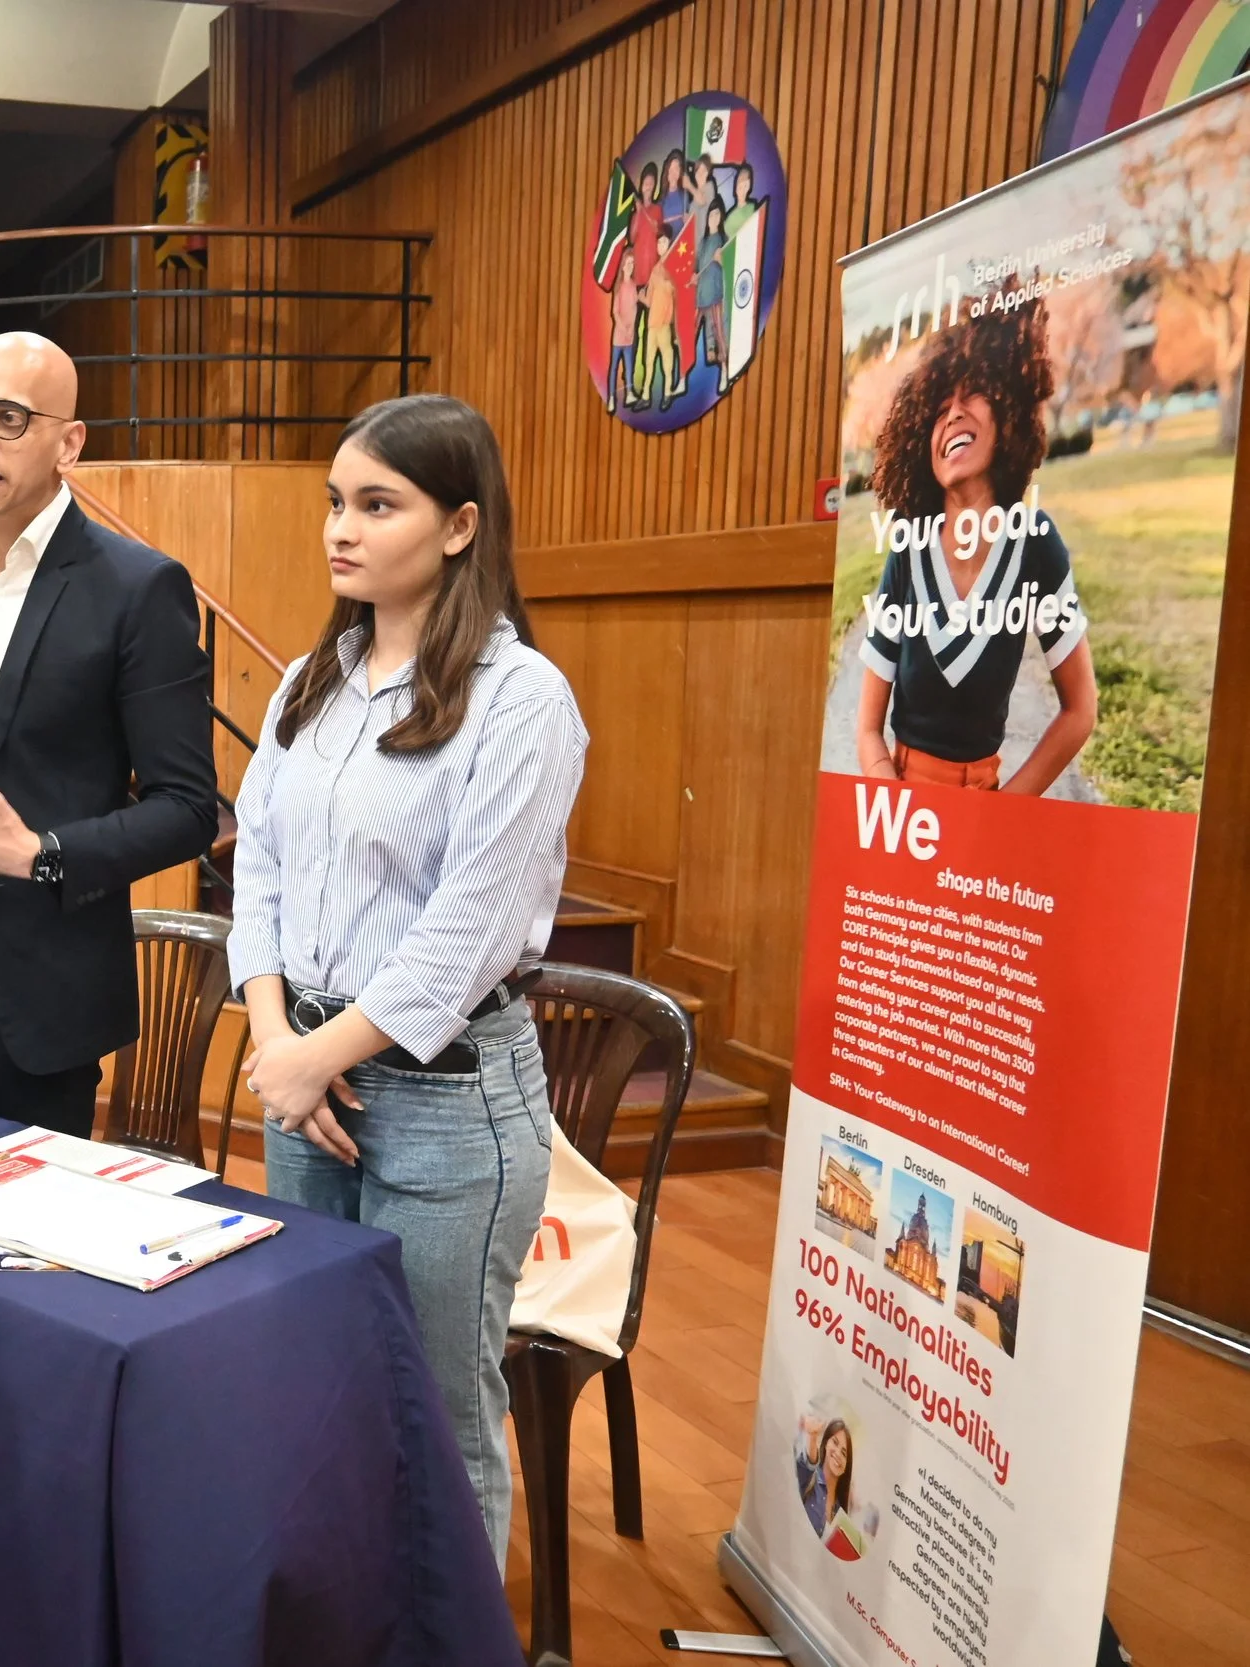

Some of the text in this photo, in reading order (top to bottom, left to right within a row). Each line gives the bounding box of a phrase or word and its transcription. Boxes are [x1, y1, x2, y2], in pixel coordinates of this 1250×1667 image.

[970, 248, 1133, 319] of Applied Sciences
[973, 222, 1107, 287] Berlin University
[870, 484, 1050, 561] Your goal.
[862, 581, 1088, 638] Your studies.
[855, 783, 940, 861] We
[846, 885, 1042, 945] Six schools in three cities, with students from
[936, 867, 1054, 914] shape the future
[842, 919, 1037, 987] CORE Principle gives you a flexible, dynamic
[844, 901, 1027, 960] both Germany and all over the world. Our
[839, 955, 1032, 1033] Our Career Services support you all the way
[841, 940, 1045, 1012] and fun study framework based on your needs.
[835, 1011, 1025, 1093] corporate partners, we are proud to say that
[836, 994, 1034, 1075] entering the job market. With more than 3500
[838, 973, 1035, 1057] from defining your career path to successfully
[832, 1043, 884, 1076] in Germany.
[833, 1027, 1026, 1115] three quarters of our alumni start their career
[830, 1072, 1029, 1176] SRH: Your Gateway to an International Career!
[839, 1125, 868, 1150] Berlin
[904, 1155, 946, 1189] Dresden
[972, 1191, 1018, 1235] Hamburg
[800, 1238, 992, 1397] 100 Nationalities
[795, 1288, 845, 1345] 96%
[851, 1323, 1010, 1486] Employability
[894, 1484, 932, 1527] Germany
[933, 1517, 968, 1558] because
[982, 1569, 992, 1585] an
[920, 1486, 995, 1565] Master's degree in
[927, 1475, 961, 1509] decided
[962, 1504, 971, 1519] to
[972, 1515, 982, 1531] do
[984, 1527, 997, 1549] my
[891, 1503, 989, 1604] attractive place to study.
[916, 1543, 988, 1627] German university
[870, 1617, 909, 1665] Computer
[888, 1560, 986, 1666] respected by employers
[912, 1562, 986, 1647] degrees are highly
[932, 1622, 975, 1667] worldwid
